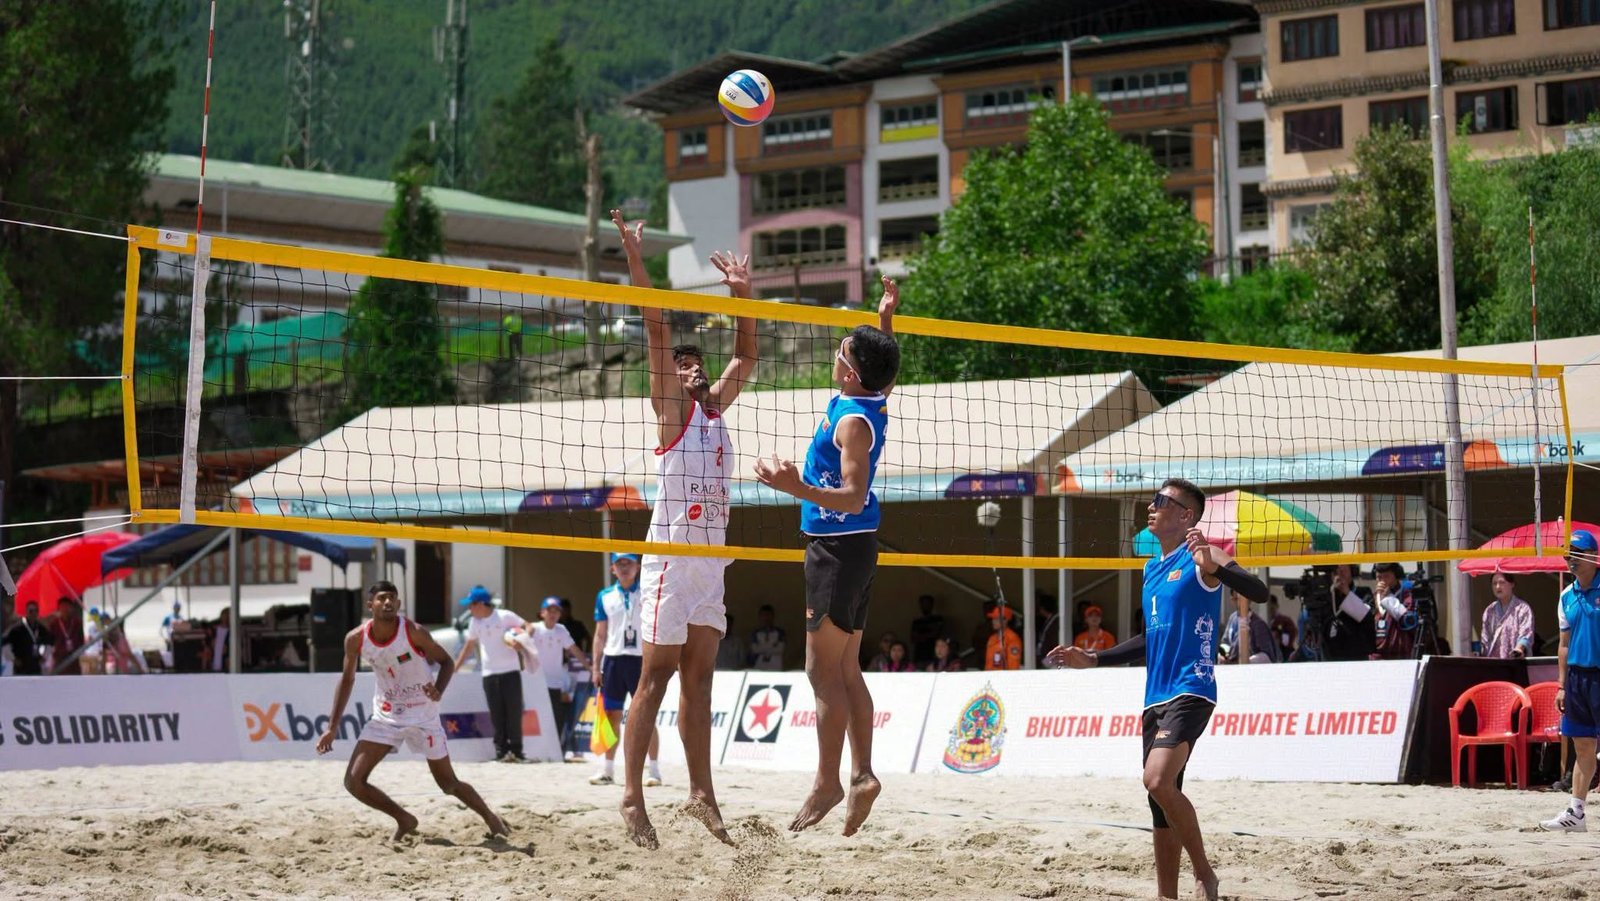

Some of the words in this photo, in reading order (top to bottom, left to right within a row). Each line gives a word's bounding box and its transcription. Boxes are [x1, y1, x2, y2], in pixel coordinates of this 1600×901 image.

[1151, 595, 1158, 616] 1
[13, 712, 180, 746] SOLIDARITY
[788, 710, 818, 728] KAR
[1025, 715, 1103, 738] BHUTAN
[1210, 712, 1299, 736] PRIVATE
[1304, 711, 1397, 735] LIMITED
